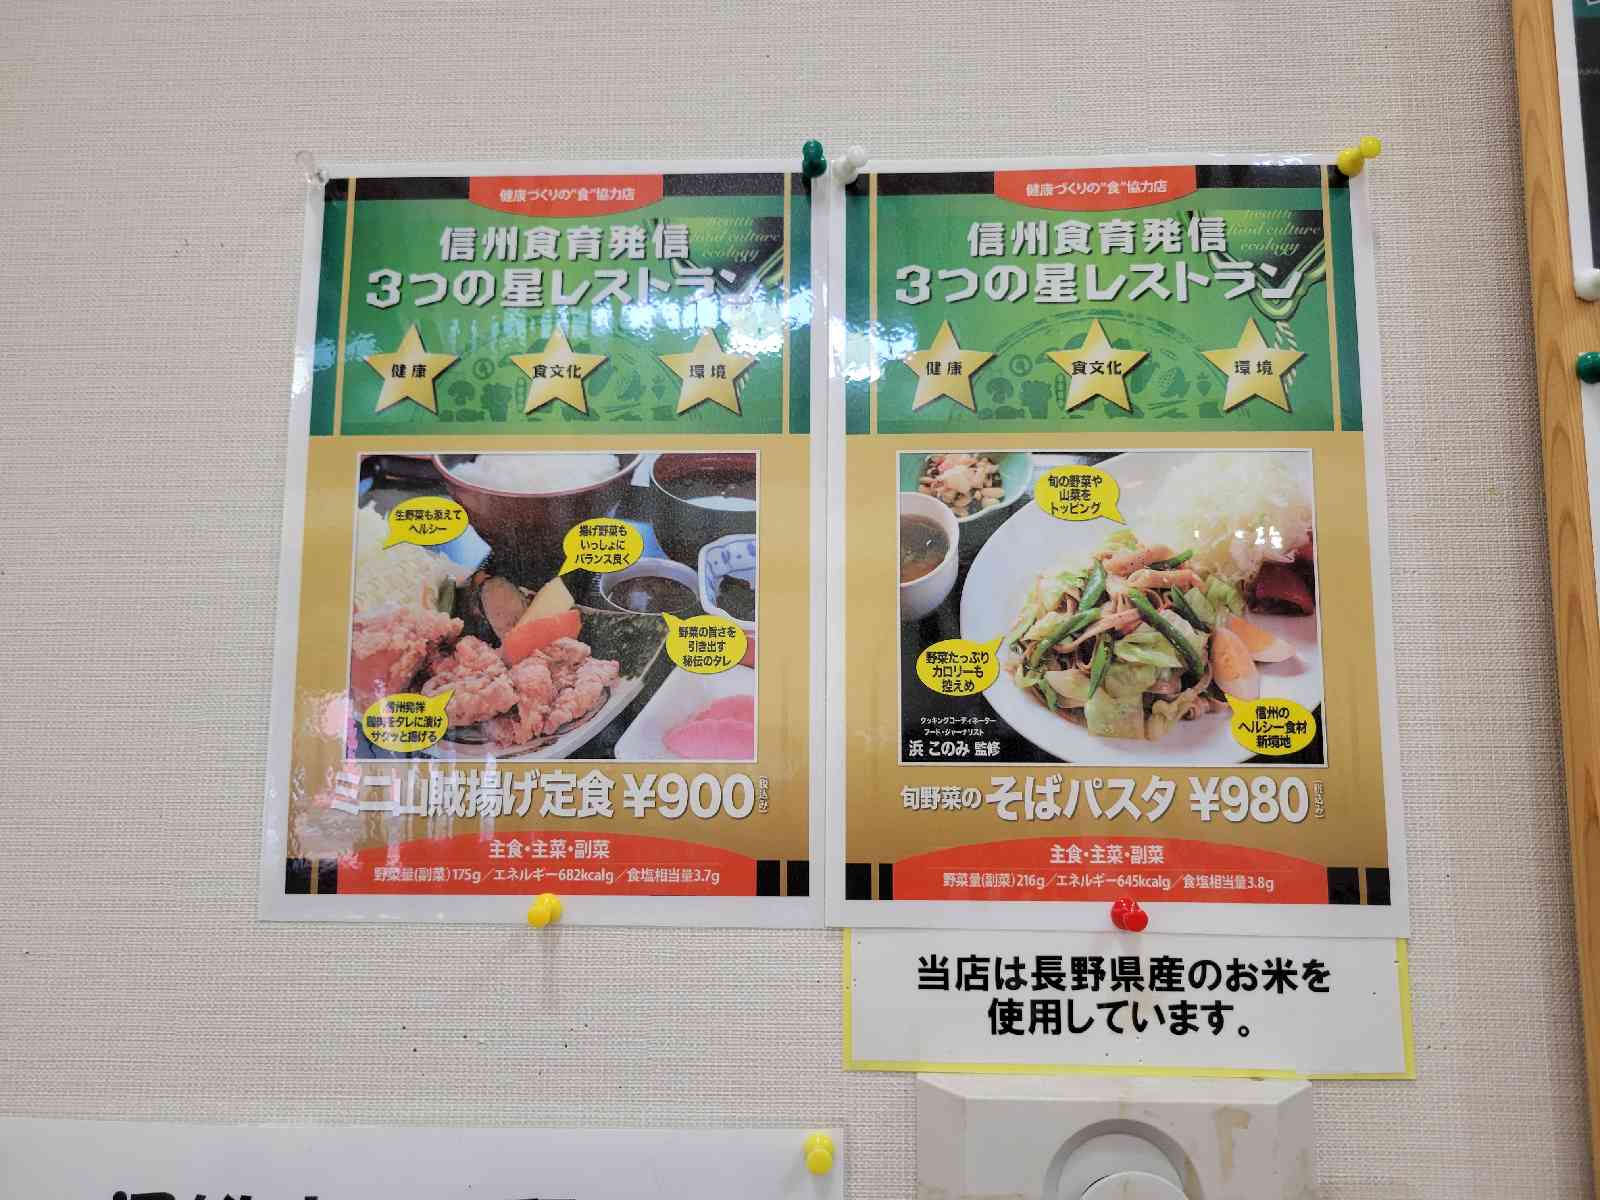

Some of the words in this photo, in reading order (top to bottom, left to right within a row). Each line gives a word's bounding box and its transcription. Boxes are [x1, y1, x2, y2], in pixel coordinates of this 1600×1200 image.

[440, 224, 690, 262] 信州食育発信
[967, 215, 1229, 257] 信州食育発信
[895, 260, 1302, 305] 3つの星レストラン
[391, 364, 427, 380] 健康
[532, 364, 582, 380] 食文化
[689, 364, 727, 380] 環境
[926, 360, 962, 376] 健康
[1071, 360, 1123, 377] 食文化
[1234, 360, 1274, 377] 環境
[1048, 474, 1103, 488] 旬の野菜や
[1059, 488, 1091, 502] 山菜を
[1050, 501, 1102, 515] トッピング
[408, 523, 448, 535] ヘルシー
[580, 538, 625, 551] いっしょに
[575, 552, 630, 566] バランス良く
[678, 625, 737, 638] 野菜の旨さを
[688, 640, 727, 653] 引き出す
[682, 655, 732, 668] 秘伝のタレ
[926, 650, 990, 665] 野菜たっぷり
[932, 664, 984, 679] カロリーも
[942, 678, 975, 693] 控えめ
[1255, 705, 1290, 721] 信州の
[1238, 720, 1308, 735] ヘルシー食材
[908, 739, 924, 757] 浜
[928, 740, 970, 757] このみ
[974, 740, 1001, 757] 監修
[1255, 734, 1292, 749] 新境地
[900, 784, 982, 811] 旬野菜の
[984, 775, 1179, 823] そばパスタ
[917, 954, 1332, 994] 当店は長野県産のお米を
[986, 997, 1253, 1038] 使用しています。
